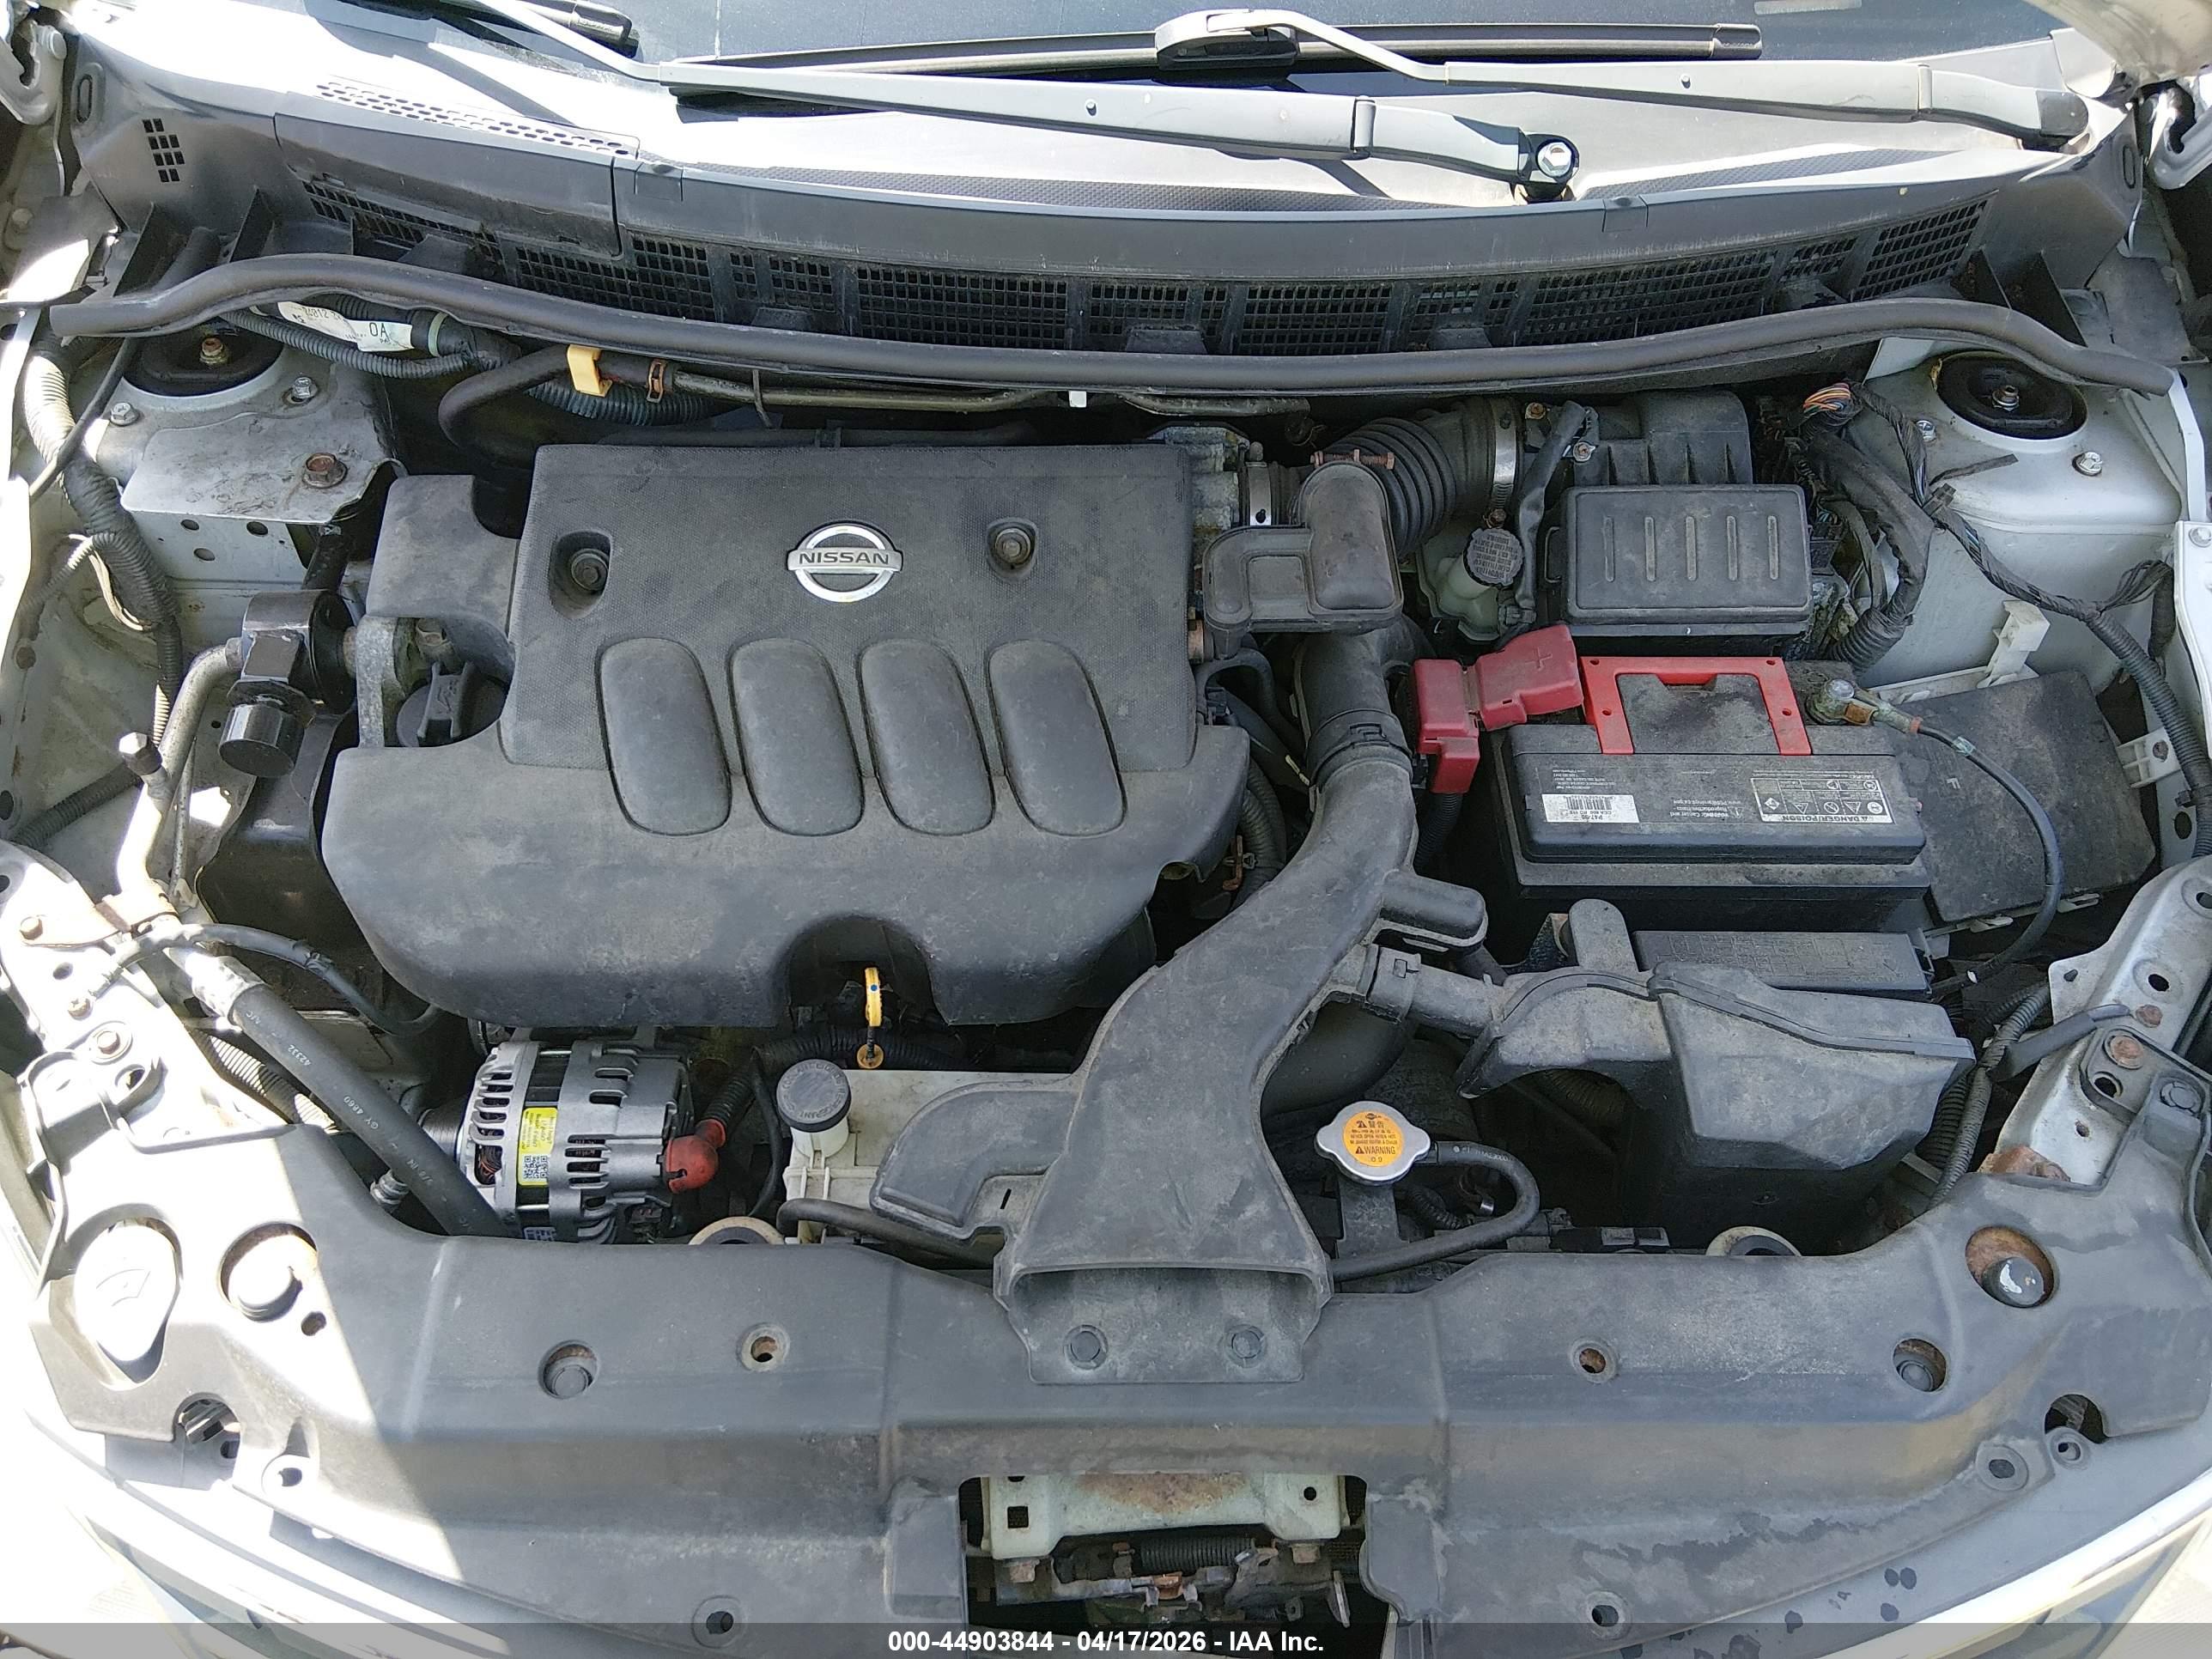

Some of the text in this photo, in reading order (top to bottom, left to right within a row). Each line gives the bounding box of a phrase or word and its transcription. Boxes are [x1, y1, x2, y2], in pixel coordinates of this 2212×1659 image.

[799, 552, 889, 565] NISSAN
[287, 1043, 313, 1066] 42332
[343, 1094, 364, 1115] 4860
[364, 1116, 380, 1130] GY
[1364, 1146, 1396, 1155] WARNING
